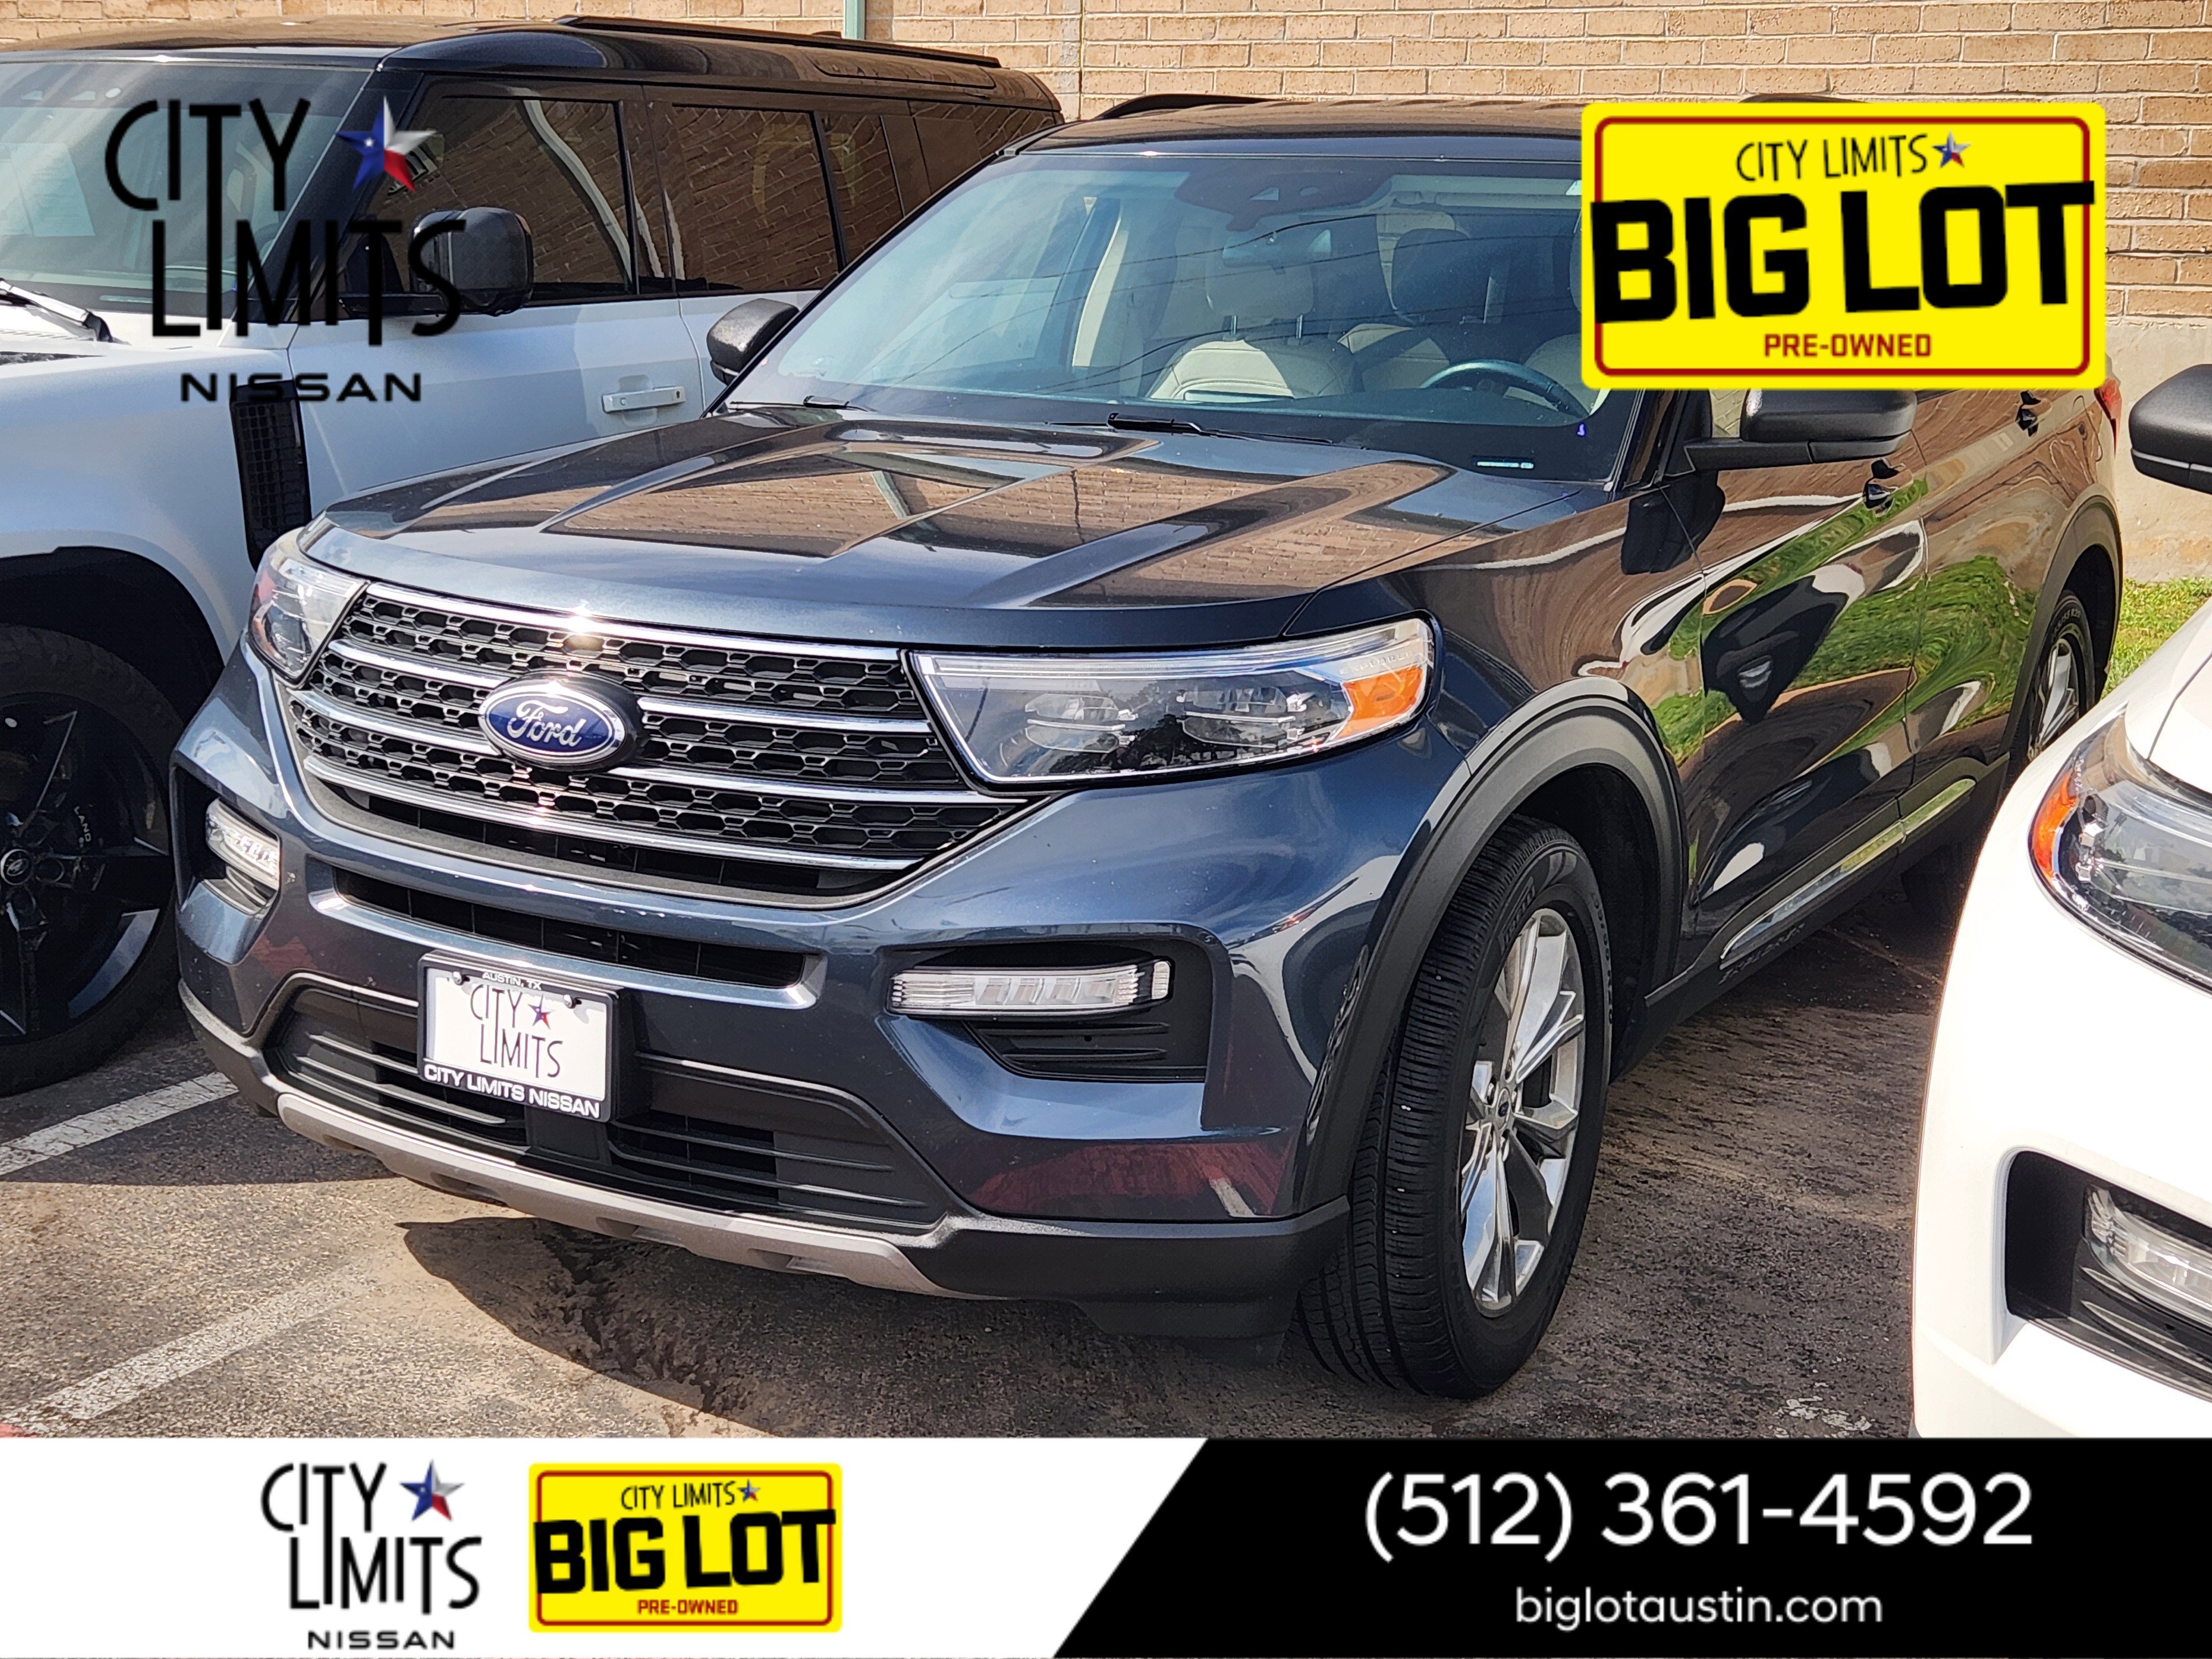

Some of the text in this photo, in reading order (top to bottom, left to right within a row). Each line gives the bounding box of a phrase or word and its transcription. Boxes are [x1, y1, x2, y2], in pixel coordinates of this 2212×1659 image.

[507, 700, 587, 747] Ford
[74, 805, 92, 842] LAND
[482, 972, 542, 990] AUSTIN, TX
[470, 984, 523, 1063] CITY
[480, 1024, 564, 1078] LIMITS
[424, 1063, 600, 1119] CITY LIMITS NISSAN
